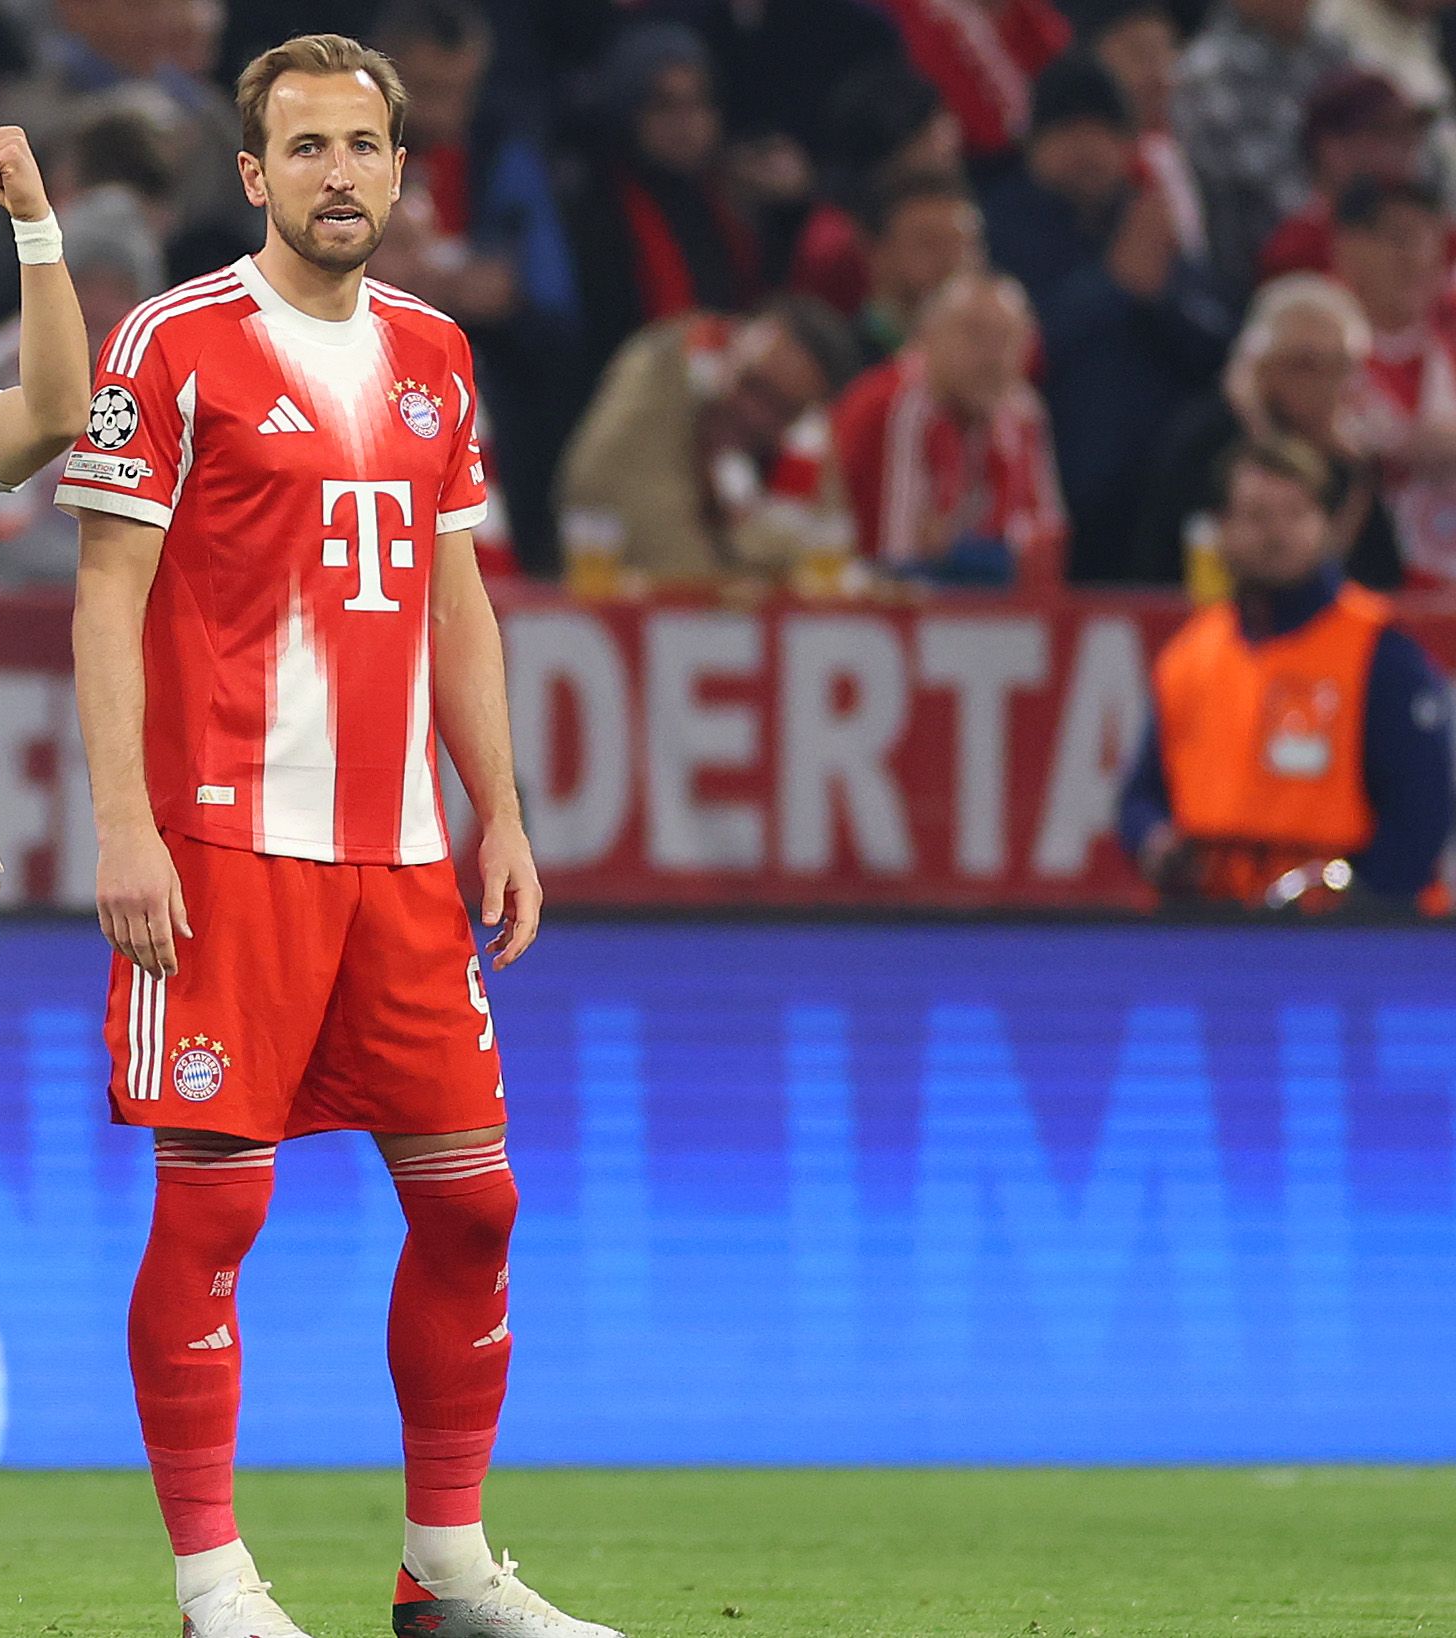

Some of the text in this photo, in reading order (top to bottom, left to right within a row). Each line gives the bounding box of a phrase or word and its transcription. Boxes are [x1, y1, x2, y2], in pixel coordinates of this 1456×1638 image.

[103, 405, 117, 430] 6
[322, 480, 412, 612] T
[434, 608, 1149, 882] DERTA
[188, 1053, 220, 1075] BAYERN
